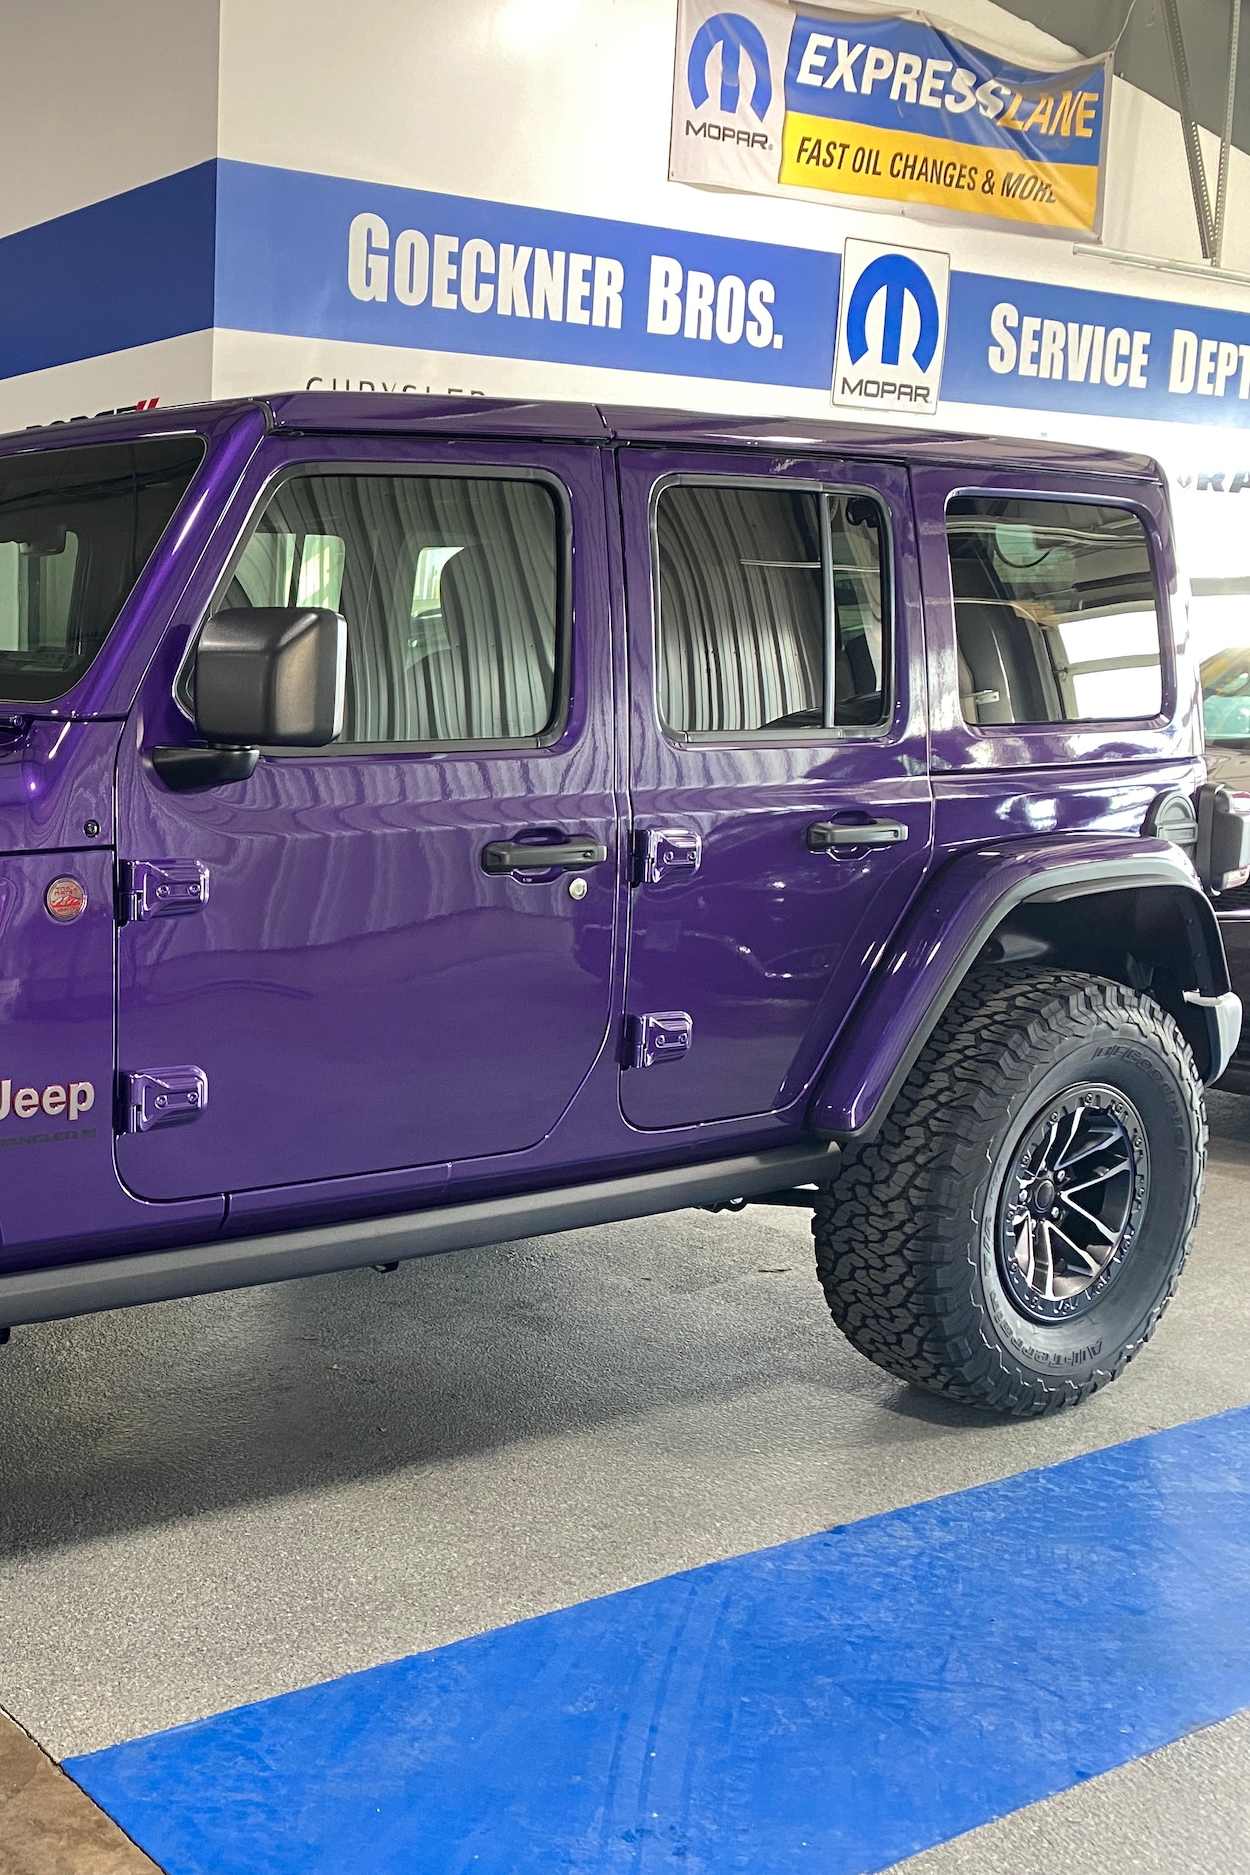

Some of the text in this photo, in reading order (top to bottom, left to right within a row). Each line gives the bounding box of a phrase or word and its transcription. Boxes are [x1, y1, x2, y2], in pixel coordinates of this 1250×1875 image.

[685, 119, 768, 150] MOPAR
[796, 136, 850, 170] FAST
[851, 146, 882, 176] OIL
[889, 151, 978, 191] CHANGES
[981, 168, 995, 195] &
[348, 211, 784, 351] GOECKNER BROS.
[987, 302, 1152, 389] SERVICE
[841, 377, 931, 404] MOPAR
